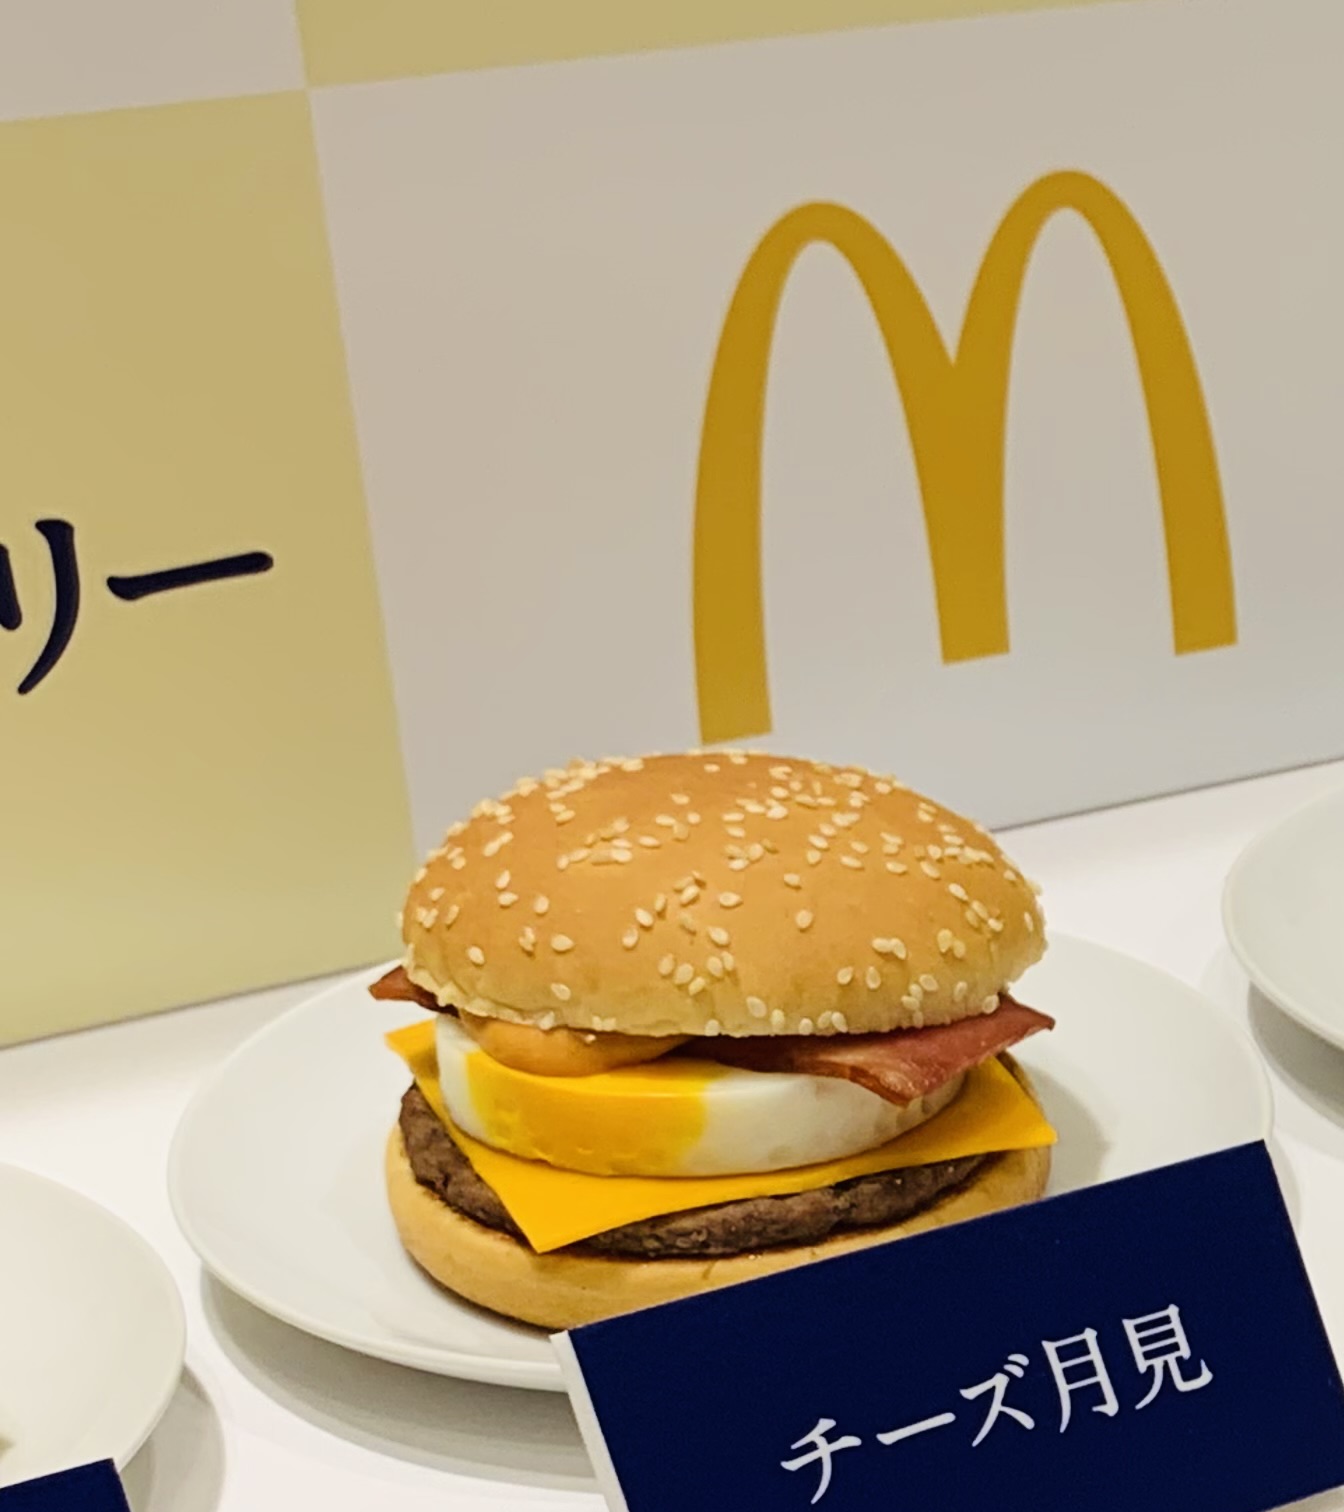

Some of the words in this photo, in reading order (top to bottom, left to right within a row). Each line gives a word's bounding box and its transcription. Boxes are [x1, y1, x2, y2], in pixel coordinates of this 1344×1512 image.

[780, 1303, 1214, 1505] チーズ月見
